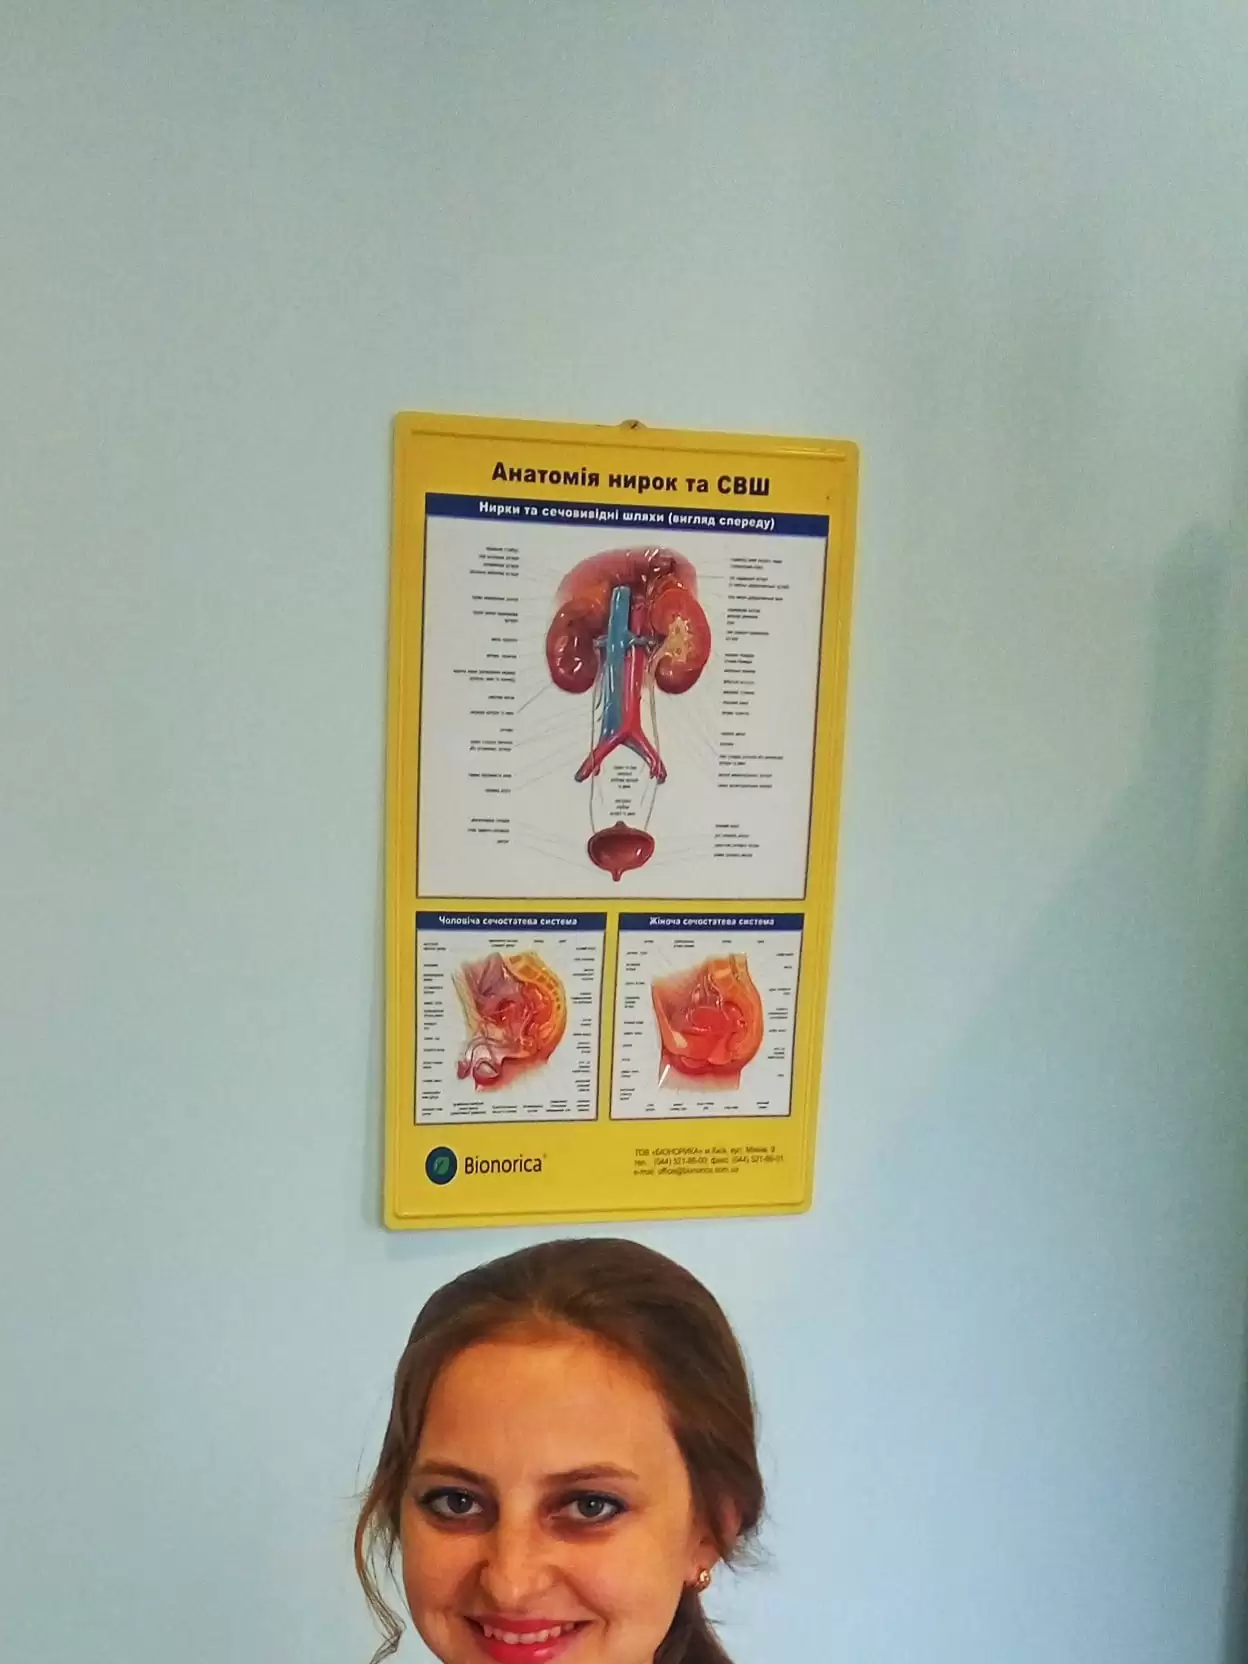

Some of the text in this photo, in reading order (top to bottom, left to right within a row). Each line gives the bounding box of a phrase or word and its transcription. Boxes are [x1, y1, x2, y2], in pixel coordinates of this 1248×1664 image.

[492, 462, 770, 496] Анатомія нирок та СВШ
[479, 501, 775, 531] Нирки та сечовивідні шляхи (вигляд спереду)
[540, 917, 577, 926] система
[739, 917, 775, 926] система
[464, 1154, 542, 1175] Bionorica
